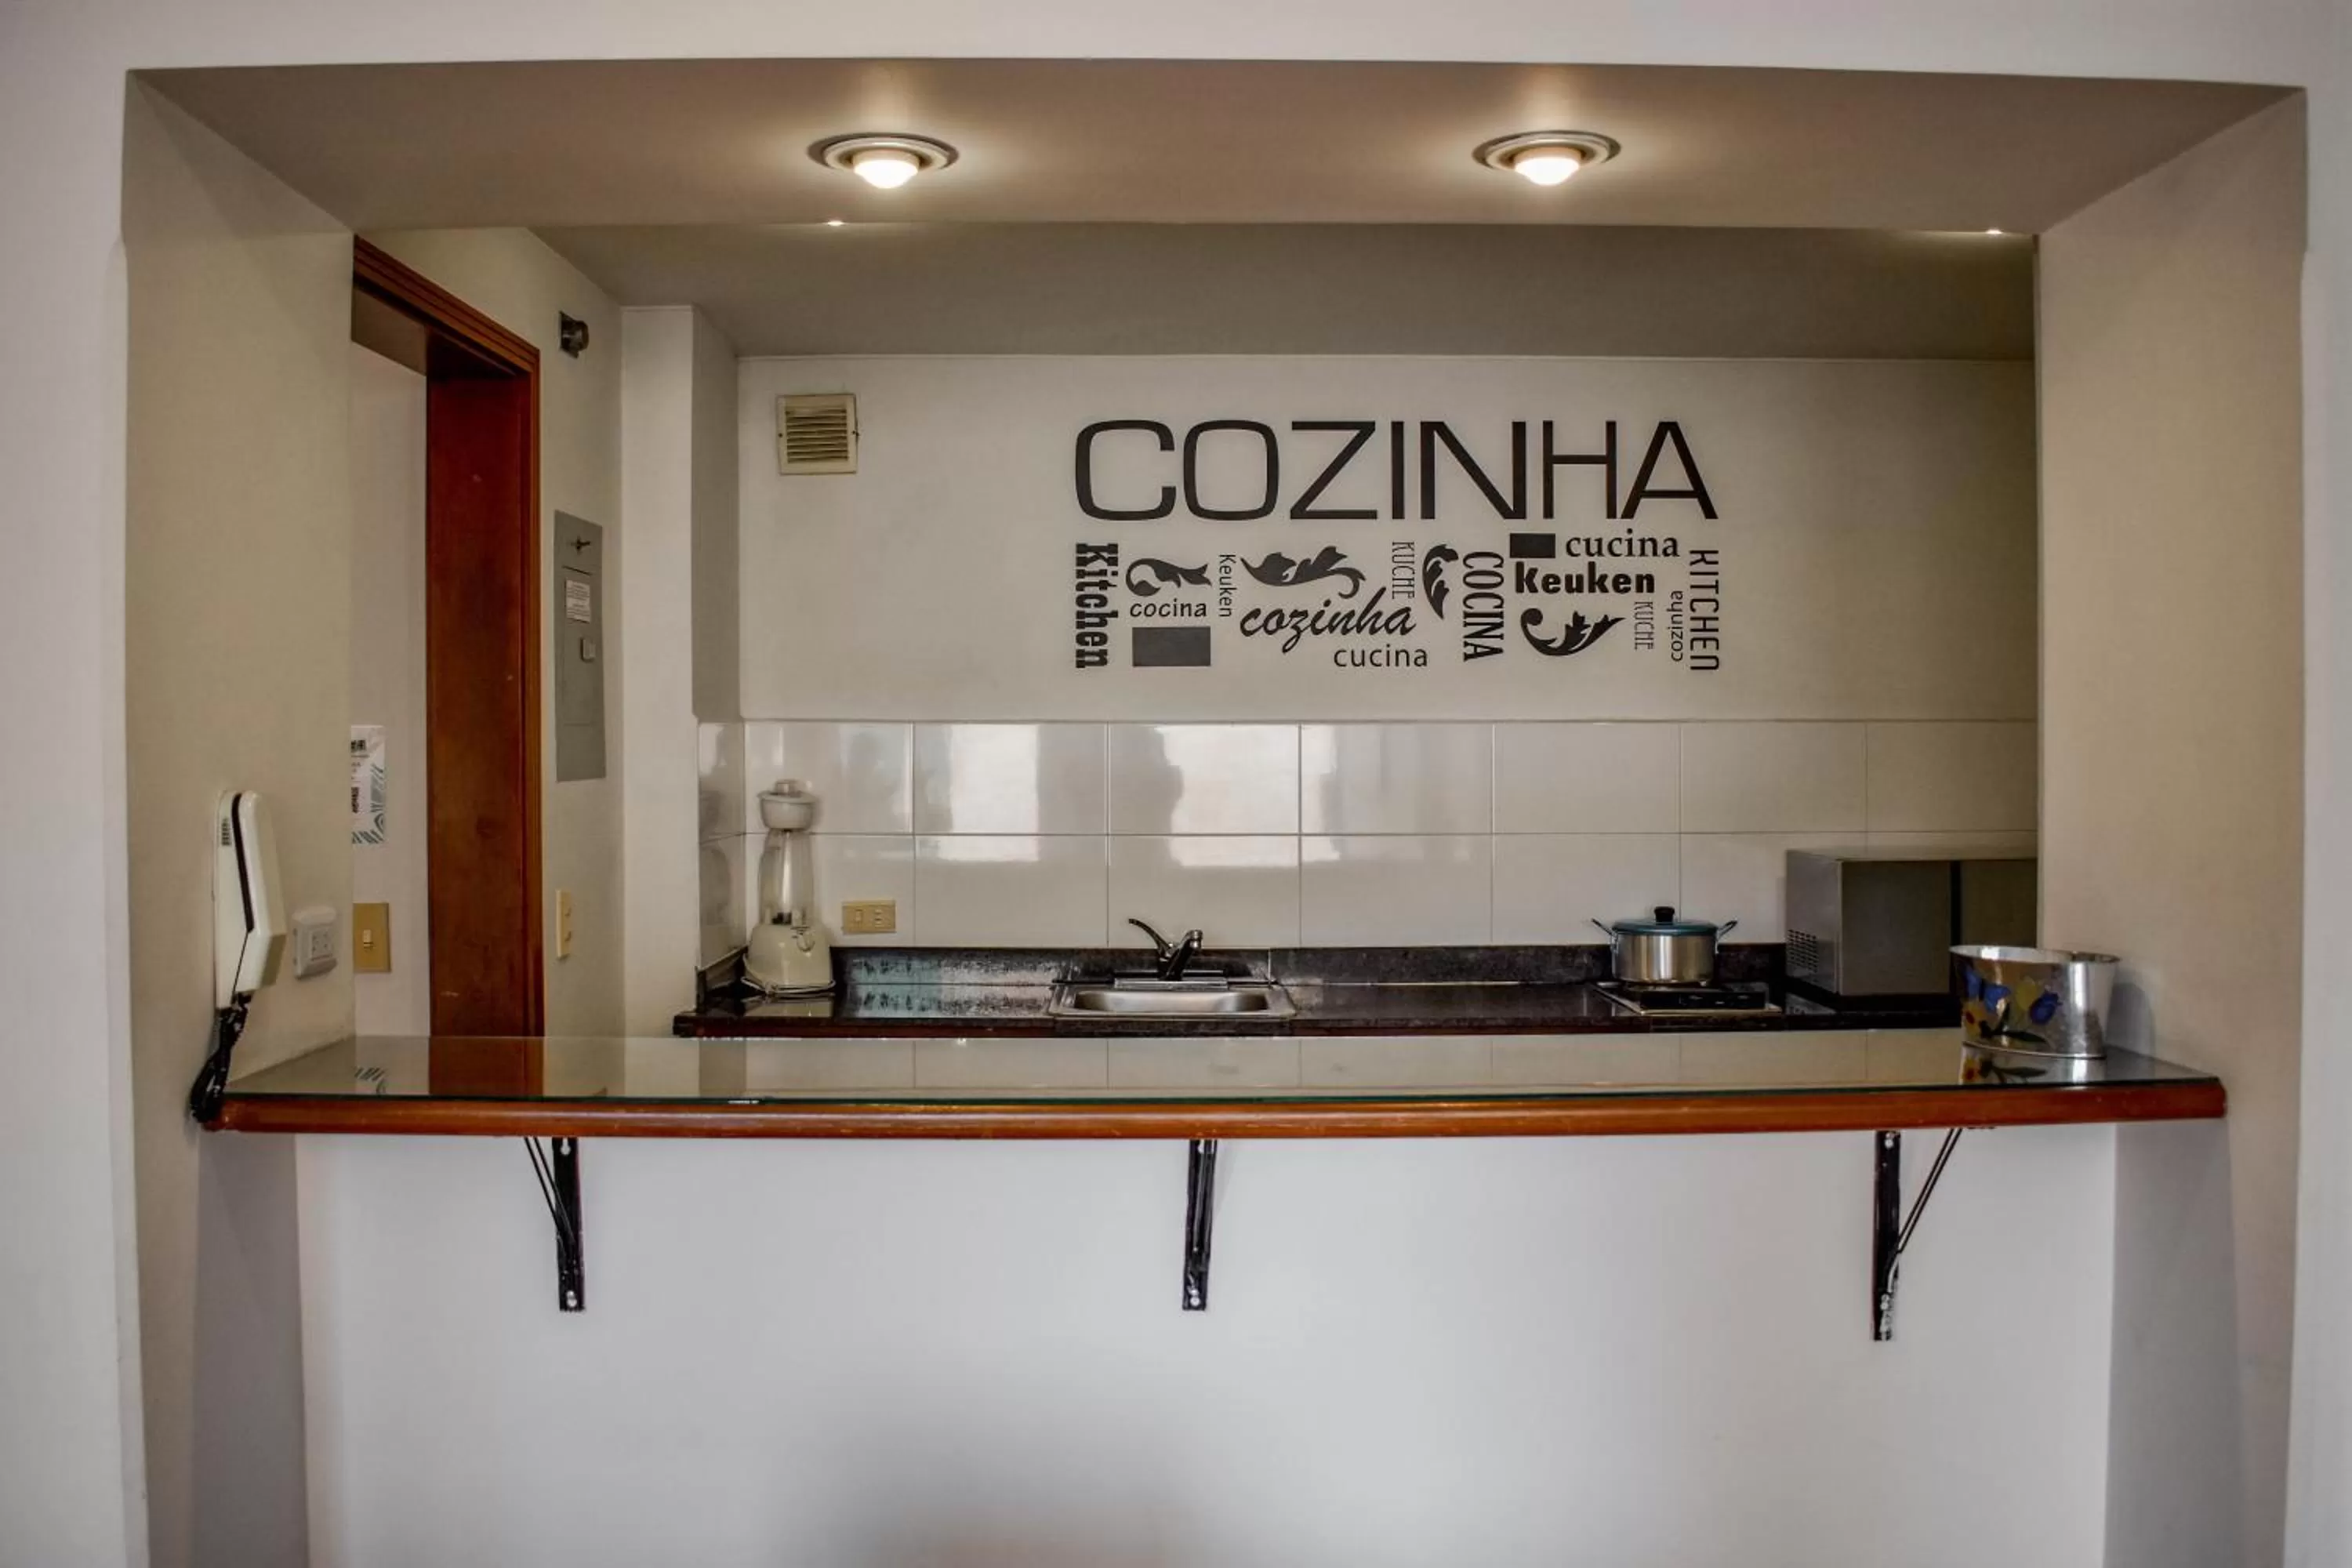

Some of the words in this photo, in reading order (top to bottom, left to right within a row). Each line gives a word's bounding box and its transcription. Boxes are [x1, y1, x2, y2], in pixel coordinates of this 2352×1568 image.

[1075, 419, 1719, 521] COZINHA
[1392, 541, 1415, 600] KUCHE
[1566, 528, 1680, 557] cucina
[1075, 543, 1119, 669] Kitchen
[1130, 598, 1207, 618] cocina
[1218, 554, 1238, 617] Keuken
[1462, 551, 1504, 662] COCINA
[1240, 586, 1417, 654] cozinha
[1633, 601, 1655, 651] KUCHE
[1666, 590, 1683, 662] cozinha
[1334, 643, 1428, 667] cucina
